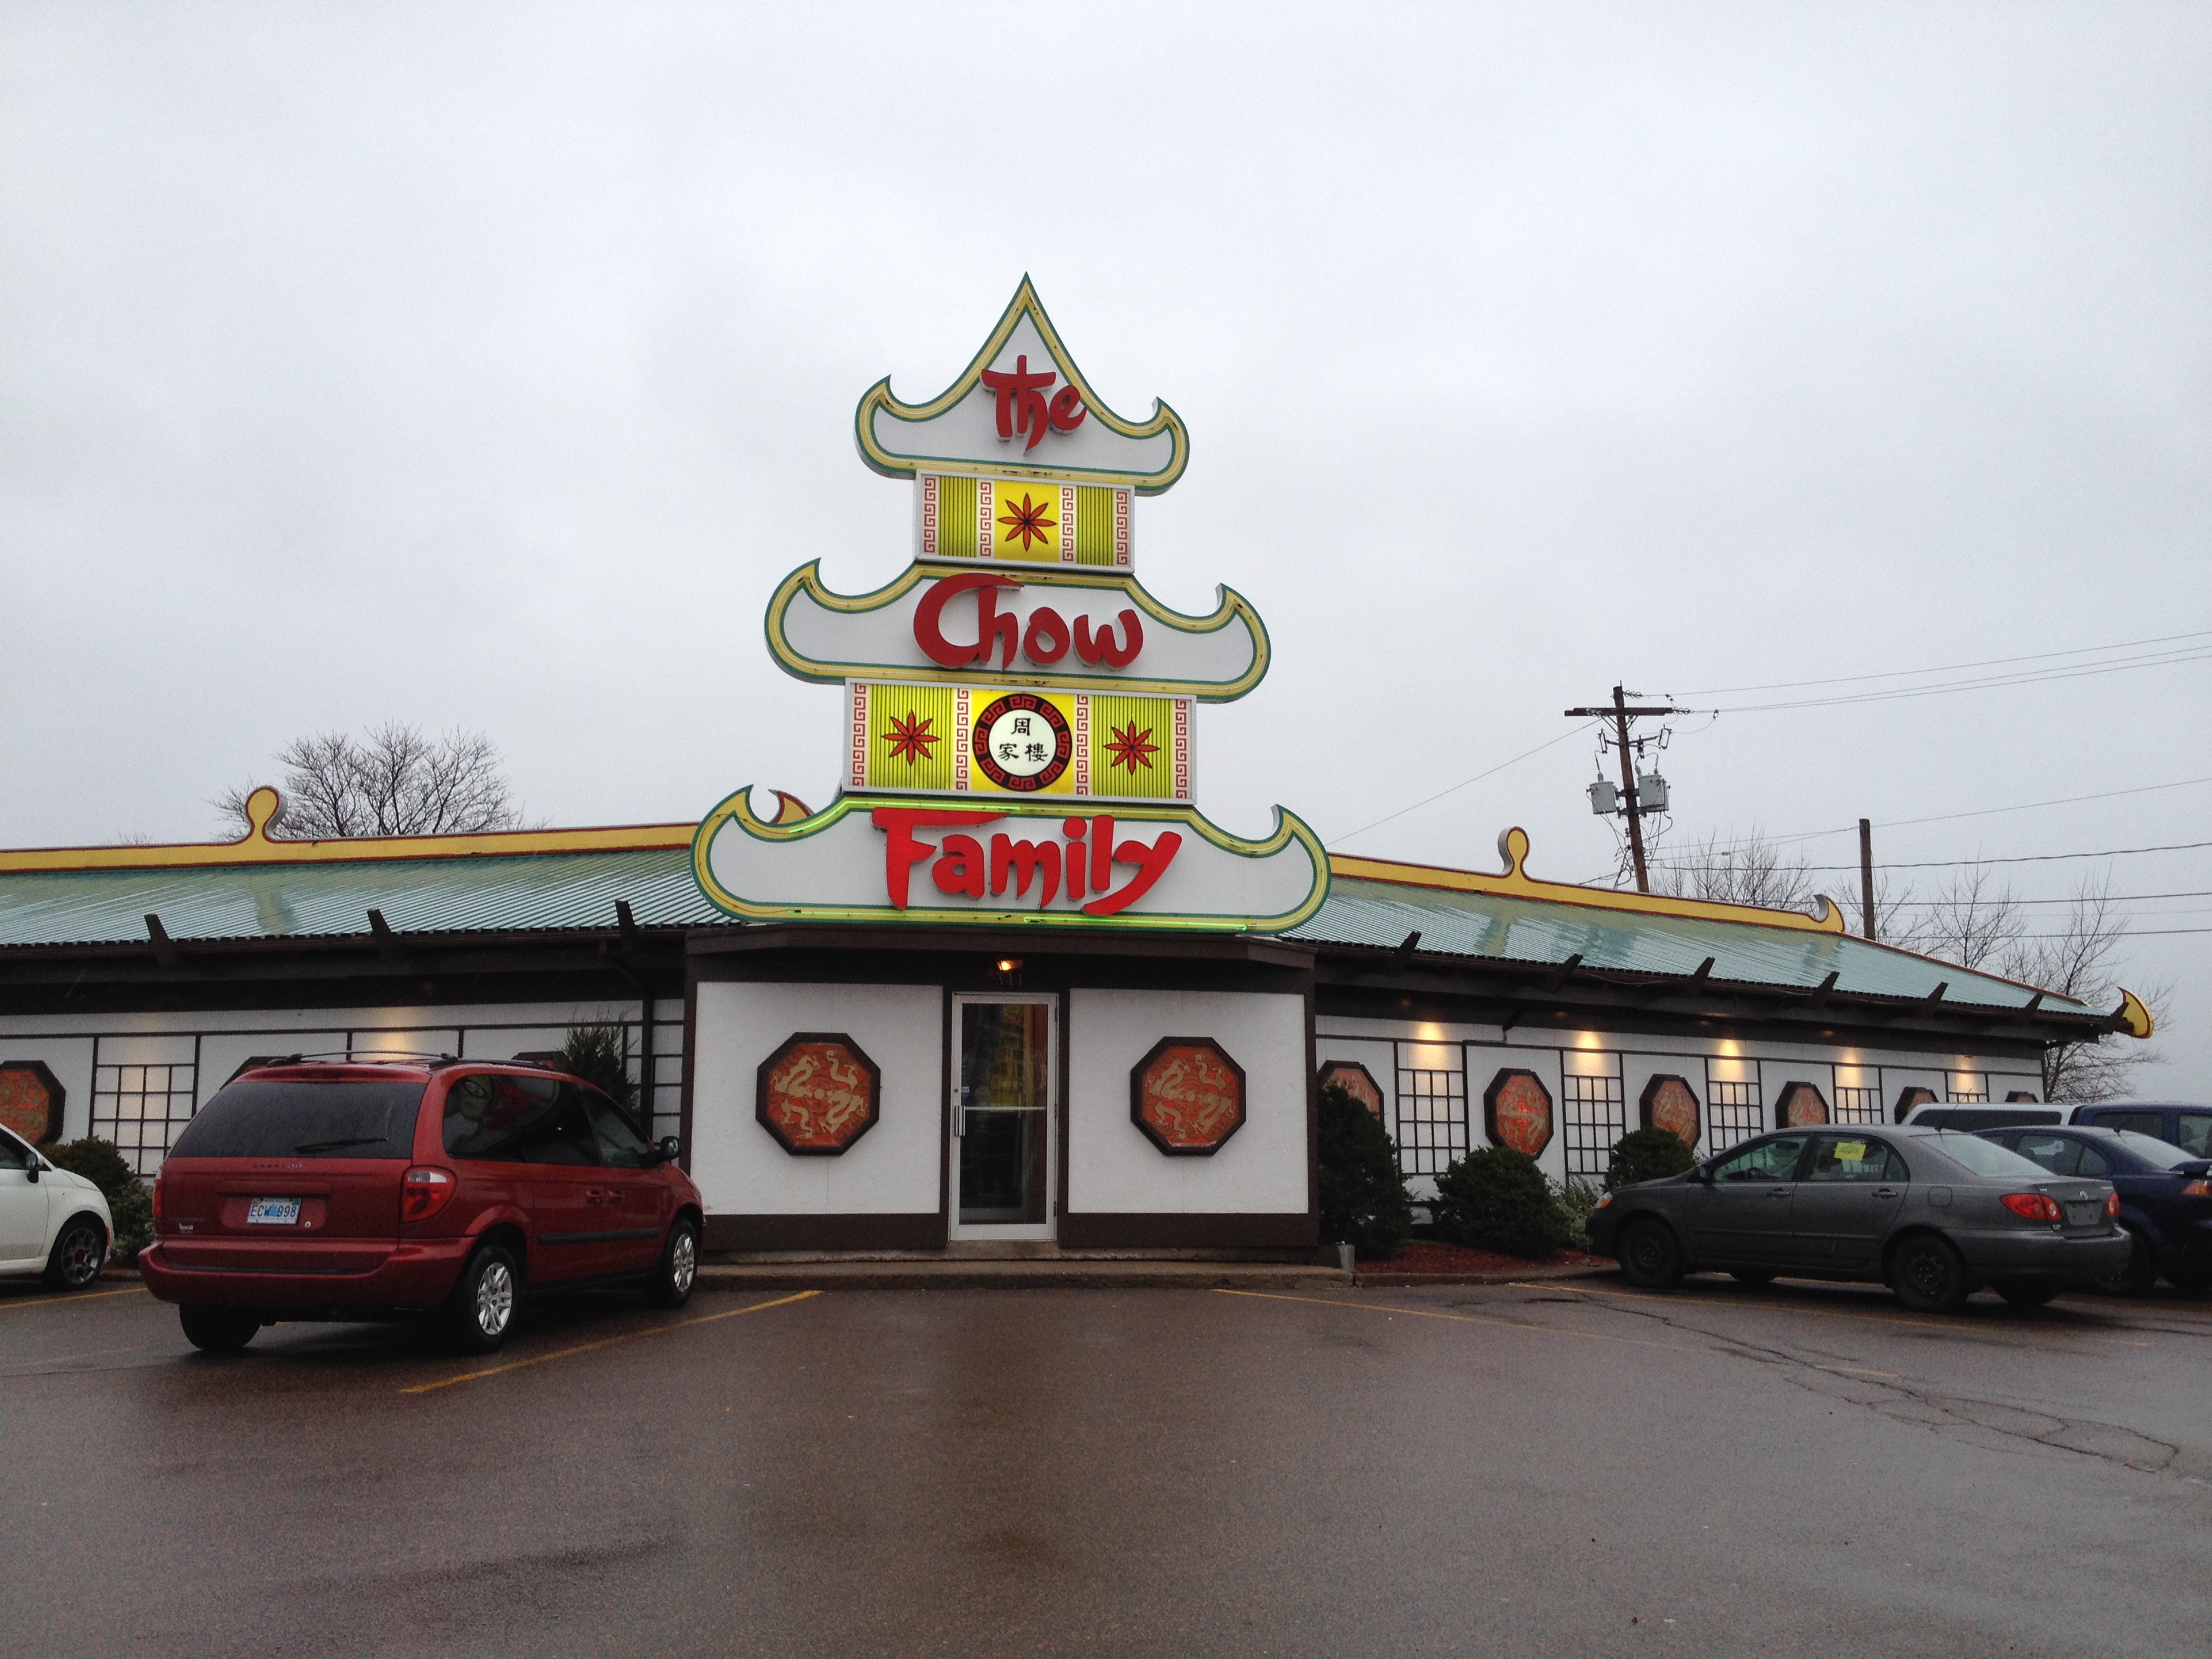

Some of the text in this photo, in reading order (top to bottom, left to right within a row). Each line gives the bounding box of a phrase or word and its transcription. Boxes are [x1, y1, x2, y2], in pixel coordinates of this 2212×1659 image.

[981, 355, 1087, 455] The
[913, 573, 1144, 670] Chow
[1010, 718, 1031, 736] 周
[872, 808, 1183, 916] Family
[277, 1206, 297, 1217] 998
